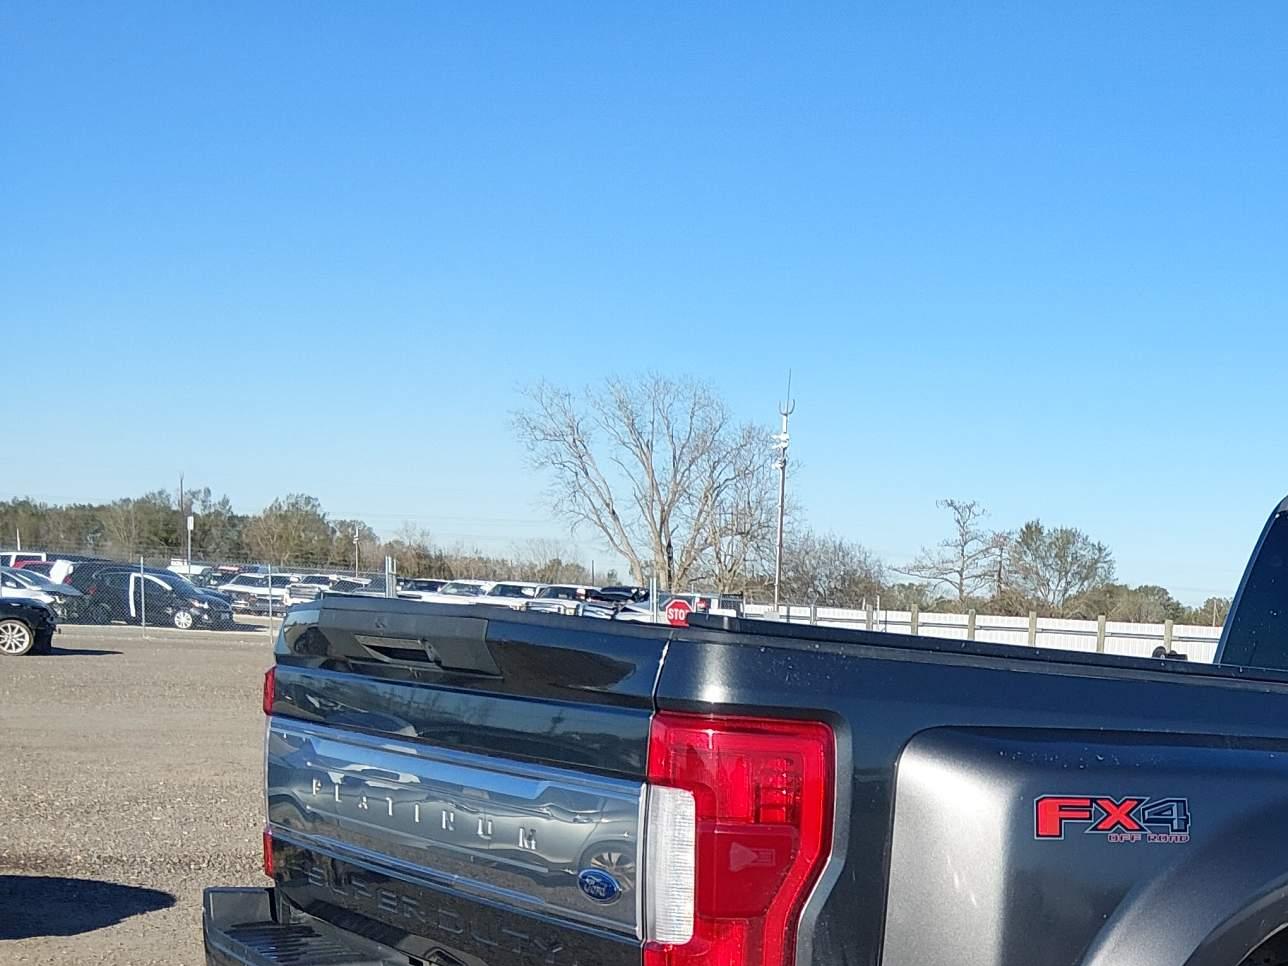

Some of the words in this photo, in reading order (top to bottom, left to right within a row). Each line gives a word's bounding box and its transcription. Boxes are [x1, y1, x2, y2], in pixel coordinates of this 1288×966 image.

[311, 777, 538, 850] PLATINUM
[1034, 795, 1190, 840] FX4
[1107, 833, 1141, 843] OFF
[1147, 833, 1190, 844] ROAD
[304, 864, 427, 924] SUPER
[436, 907, 565, 962] DUTY
